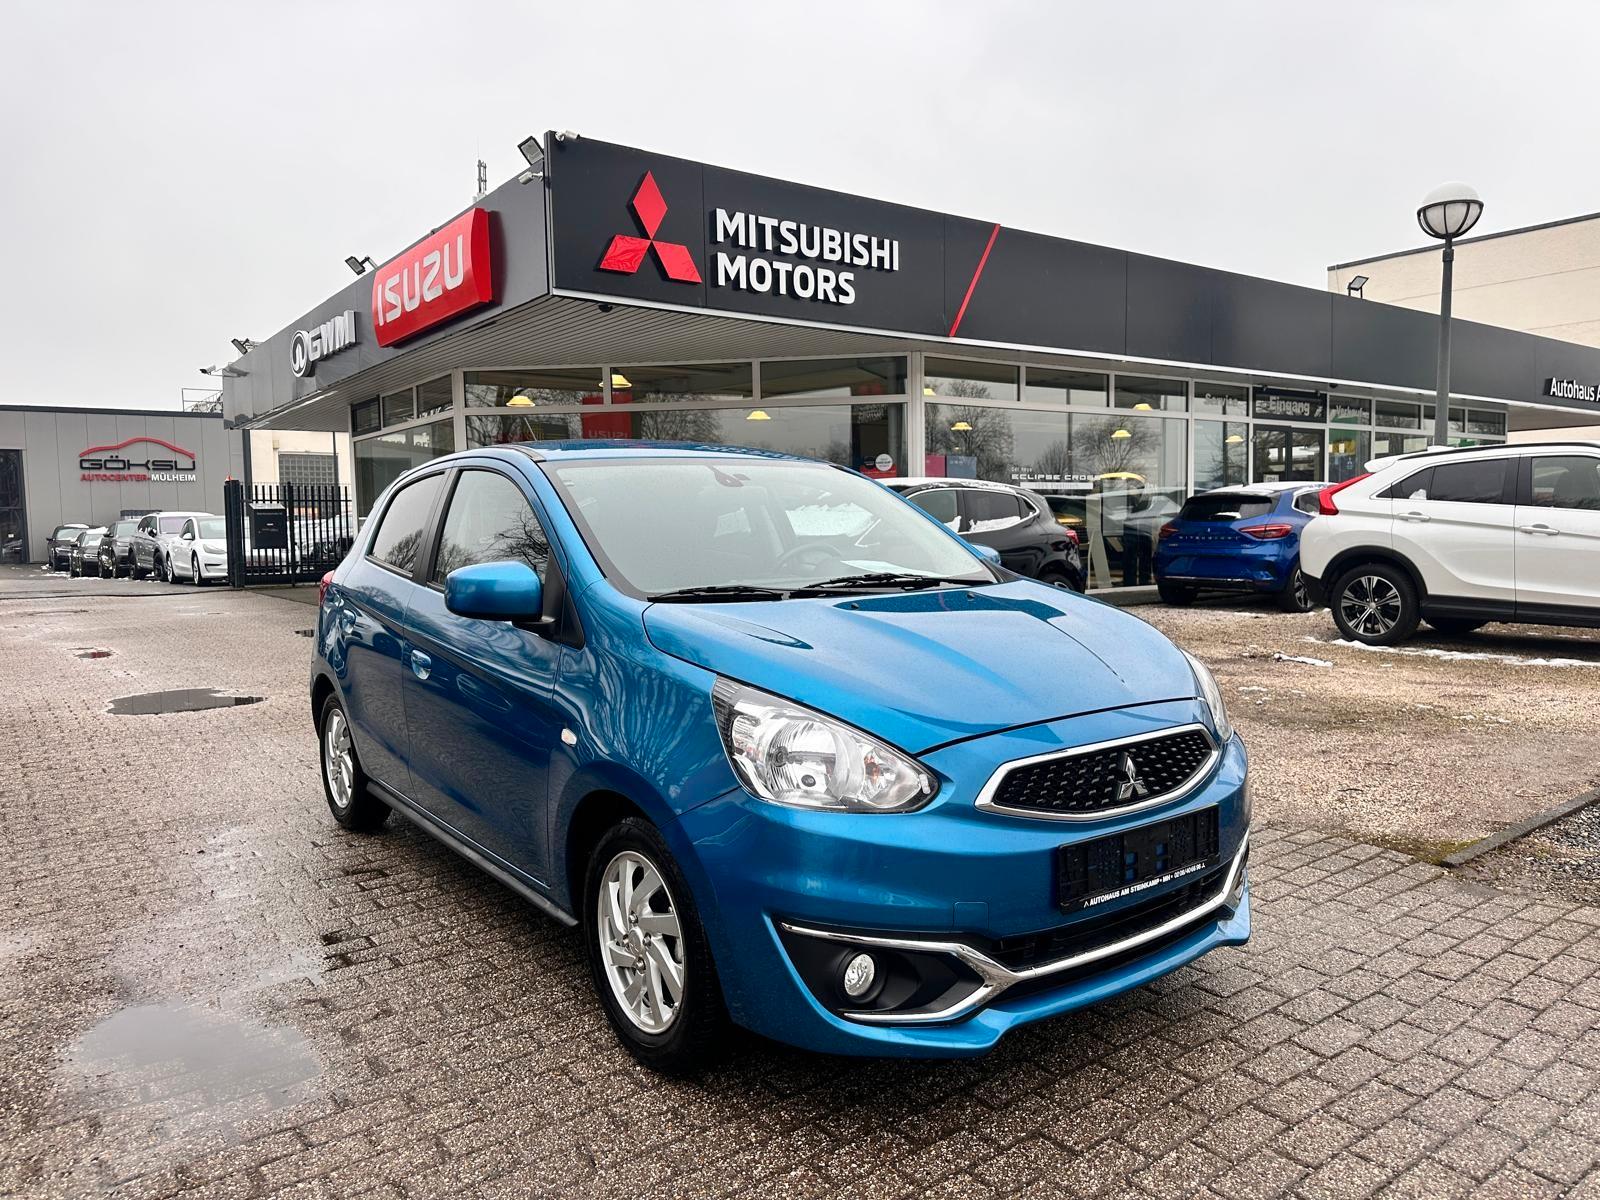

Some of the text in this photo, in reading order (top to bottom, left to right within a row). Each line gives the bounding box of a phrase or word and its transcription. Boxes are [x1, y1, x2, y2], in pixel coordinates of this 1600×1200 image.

[715, 208, 899, 271] MITSUBISHI
[378, 234, 464, 327] ISUZU
[717, 253, 856, 305] MOTORS
[1550, 377, 1595, 401] Autohaus
[1269, 396, 1310, 416] Eingang
[79, 455, 196, 471] GÖKSU
[1089, 891, 1120, 905] AUTOHAUS
[1121, 887, 1129, 896] AM
[1130, 878, 1159, 893] STEINKAMP
